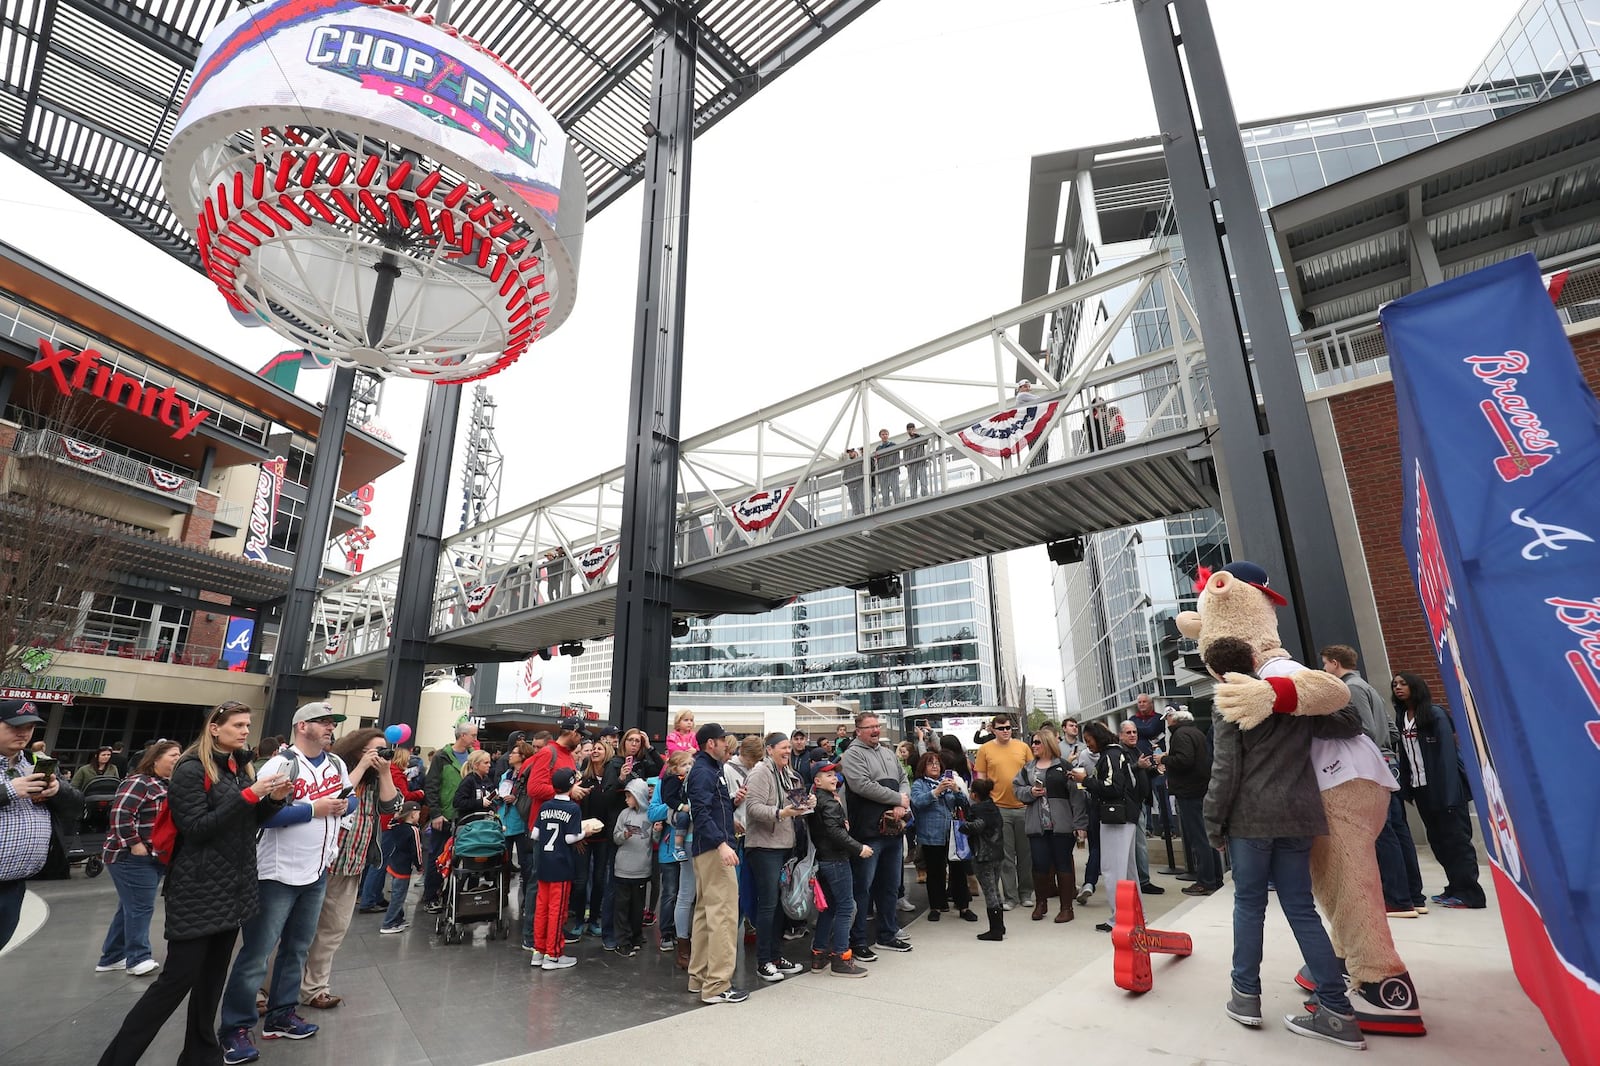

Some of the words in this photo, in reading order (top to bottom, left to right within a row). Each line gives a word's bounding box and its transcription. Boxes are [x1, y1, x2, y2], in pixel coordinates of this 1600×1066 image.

[308, 26, 435, 81] CHOP
[462, 75, 547, 167] FEST
[1463, 350, 1559, 452] Braves
[245, 470, 272, 563] raves
[9, 690, 33, 699] BROS.
[35, 692, 68, 701] BAR-B-Q
[33, 675, 107, 695] TAPROOM
[928, 699, 952, 709] Georgia
[952, 699, 973, 708] Power
[540, 809, 572, 824] SWANSON
[543, 822, 560, 852] 7
